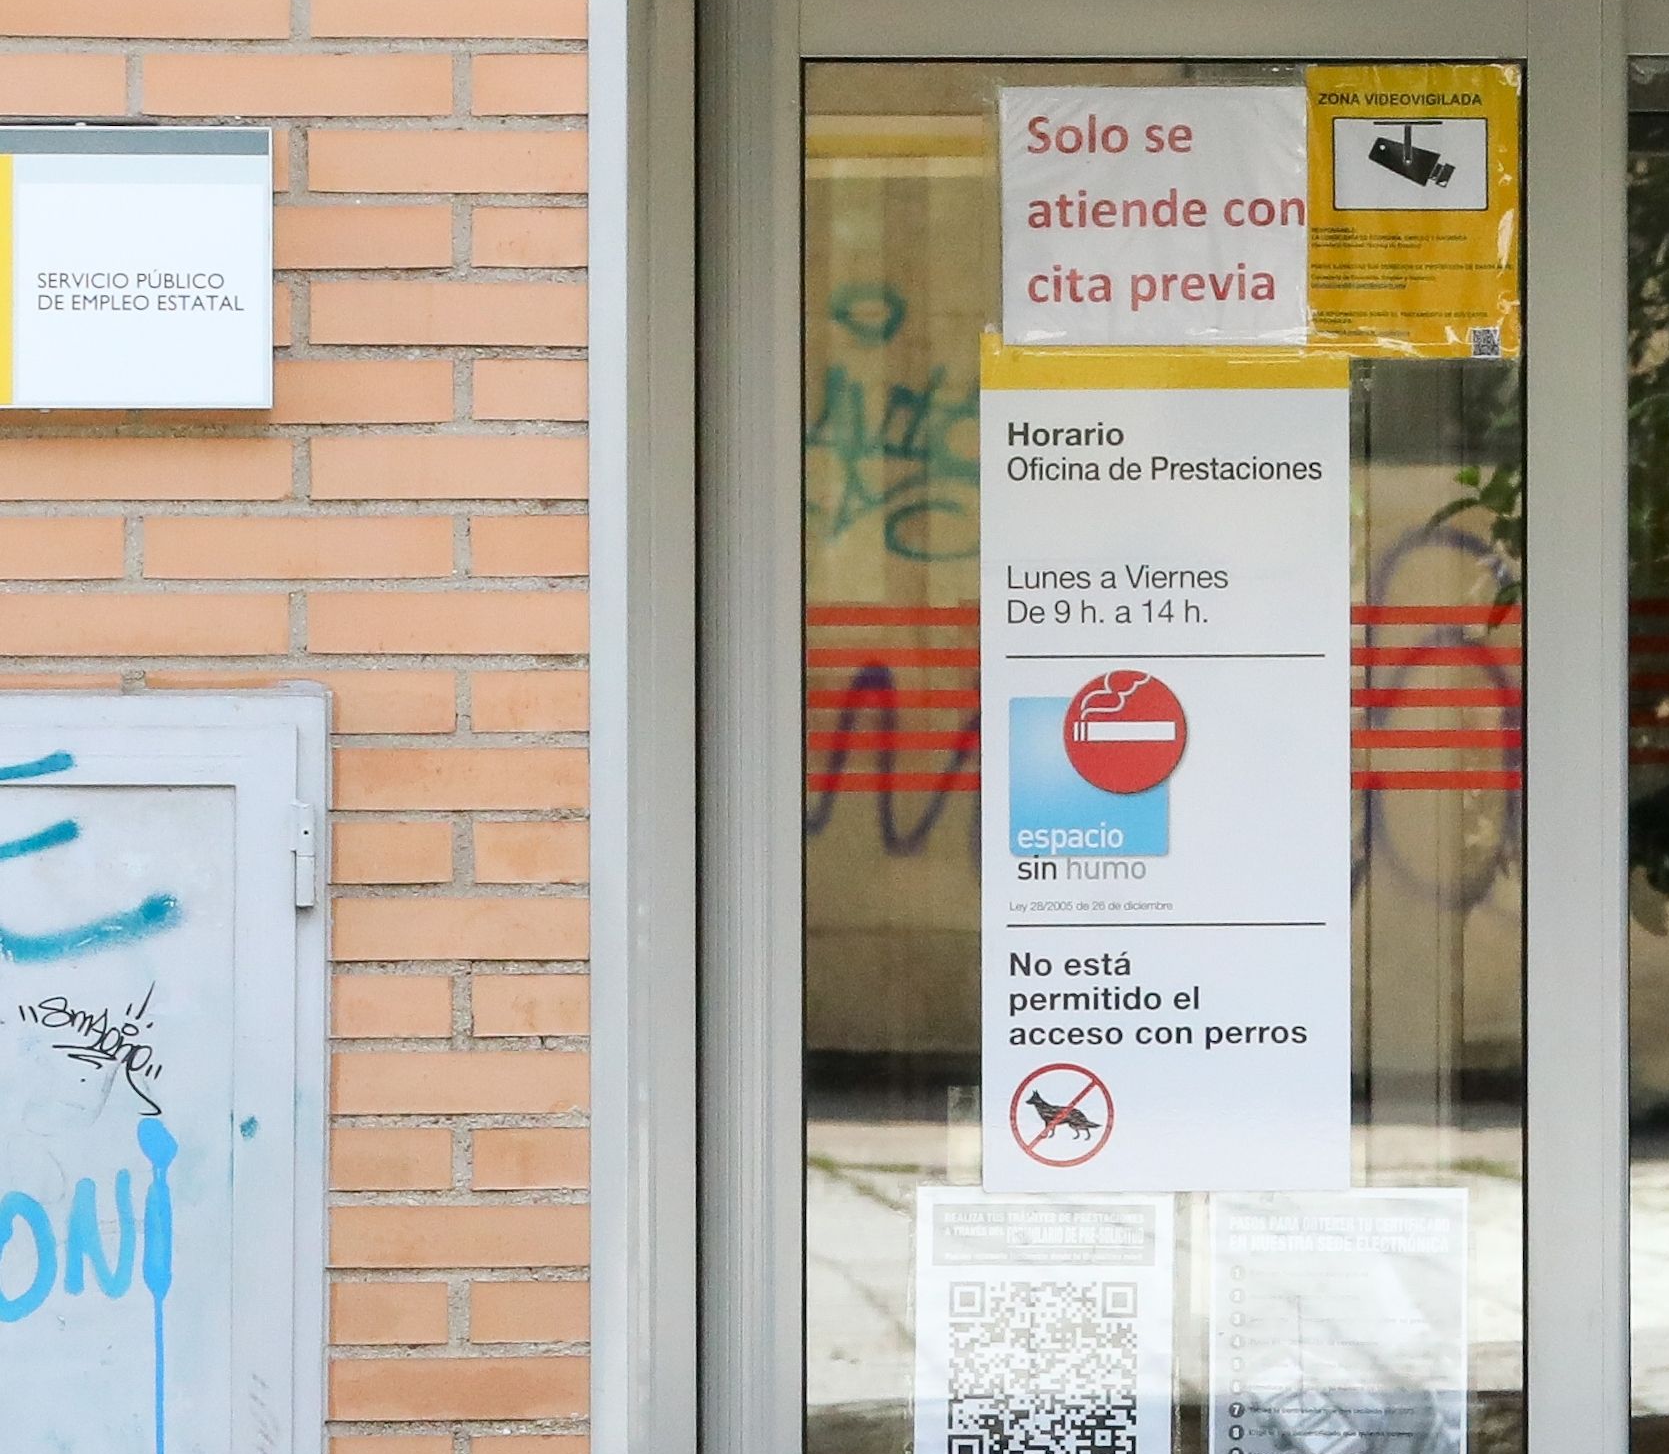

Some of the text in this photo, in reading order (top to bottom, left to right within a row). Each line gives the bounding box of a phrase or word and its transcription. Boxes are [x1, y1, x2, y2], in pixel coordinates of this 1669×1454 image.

[1318, 92, 1482, 106] ZONA VIDEOVIGILADA
[1027, 115, 1192, 154] Solo se
[1028, 188, 1306, 228] atiende con
[37, 269, 225, 289] SERVICIO PÚBLICO
[1028, 264, 1112, 304] cita
[1130, 263, 1275, 311] previa
[38, 295, 244, 311] DE EMPLEO ESTATAL
[1007, 422, 1124, 446] Horario
[1007, 456, 1322, 481] Oficina de Prestaciones
[1007, 564, 1228, 590] Lunes a Viernes
[1007, 599, 1208, 624] De 9 h. a 14 h.
[1017, 823, 1124, 855] espacio
[1017, 855, 1147, 881] sin humo
[1009, 901, 1027, 913] Ley
[1030, 901, 1073, 911] 28/2005
[1076, 901, 1089, 911] de
[1108, 901, 1121, 911] de
[1124, 901, 1173, 911] diciembre
[1010, 951, 1131, 977] No está
[1010, 986, 1199, 1017] permitido el
[1010, 1024, 1307, 1049] acceso con perros
